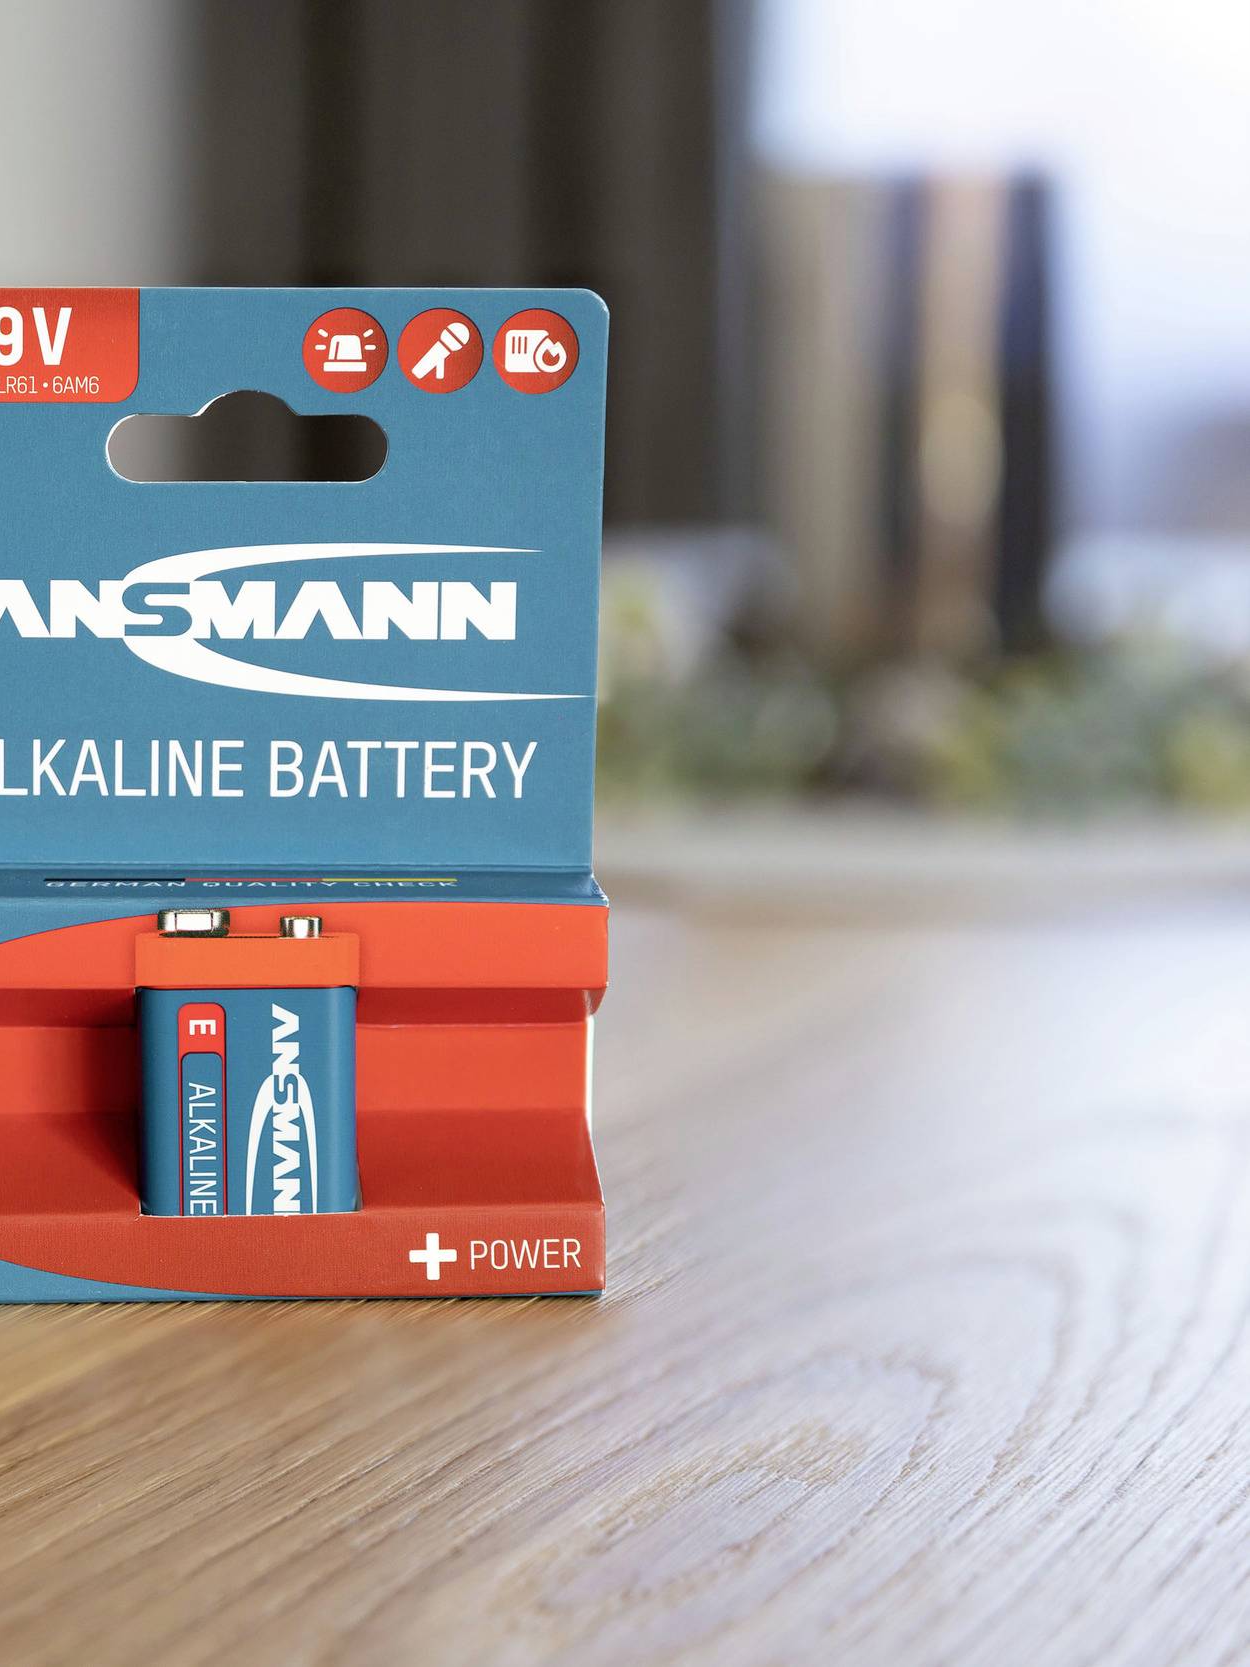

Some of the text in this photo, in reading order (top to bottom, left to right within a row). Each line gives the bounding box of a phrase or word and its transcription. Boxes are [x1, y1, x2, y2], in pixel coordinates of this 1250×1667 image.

[269, 740, 538, 799] BATTERY
[45, 880, 458, 888] GERMAN QUALITY CHECK
[188, 1019, 217, 1215] E ALKALINE
[271, 1003, 301, 1215] ANSMAN
[470, 1238, 582, 1271] POWER
